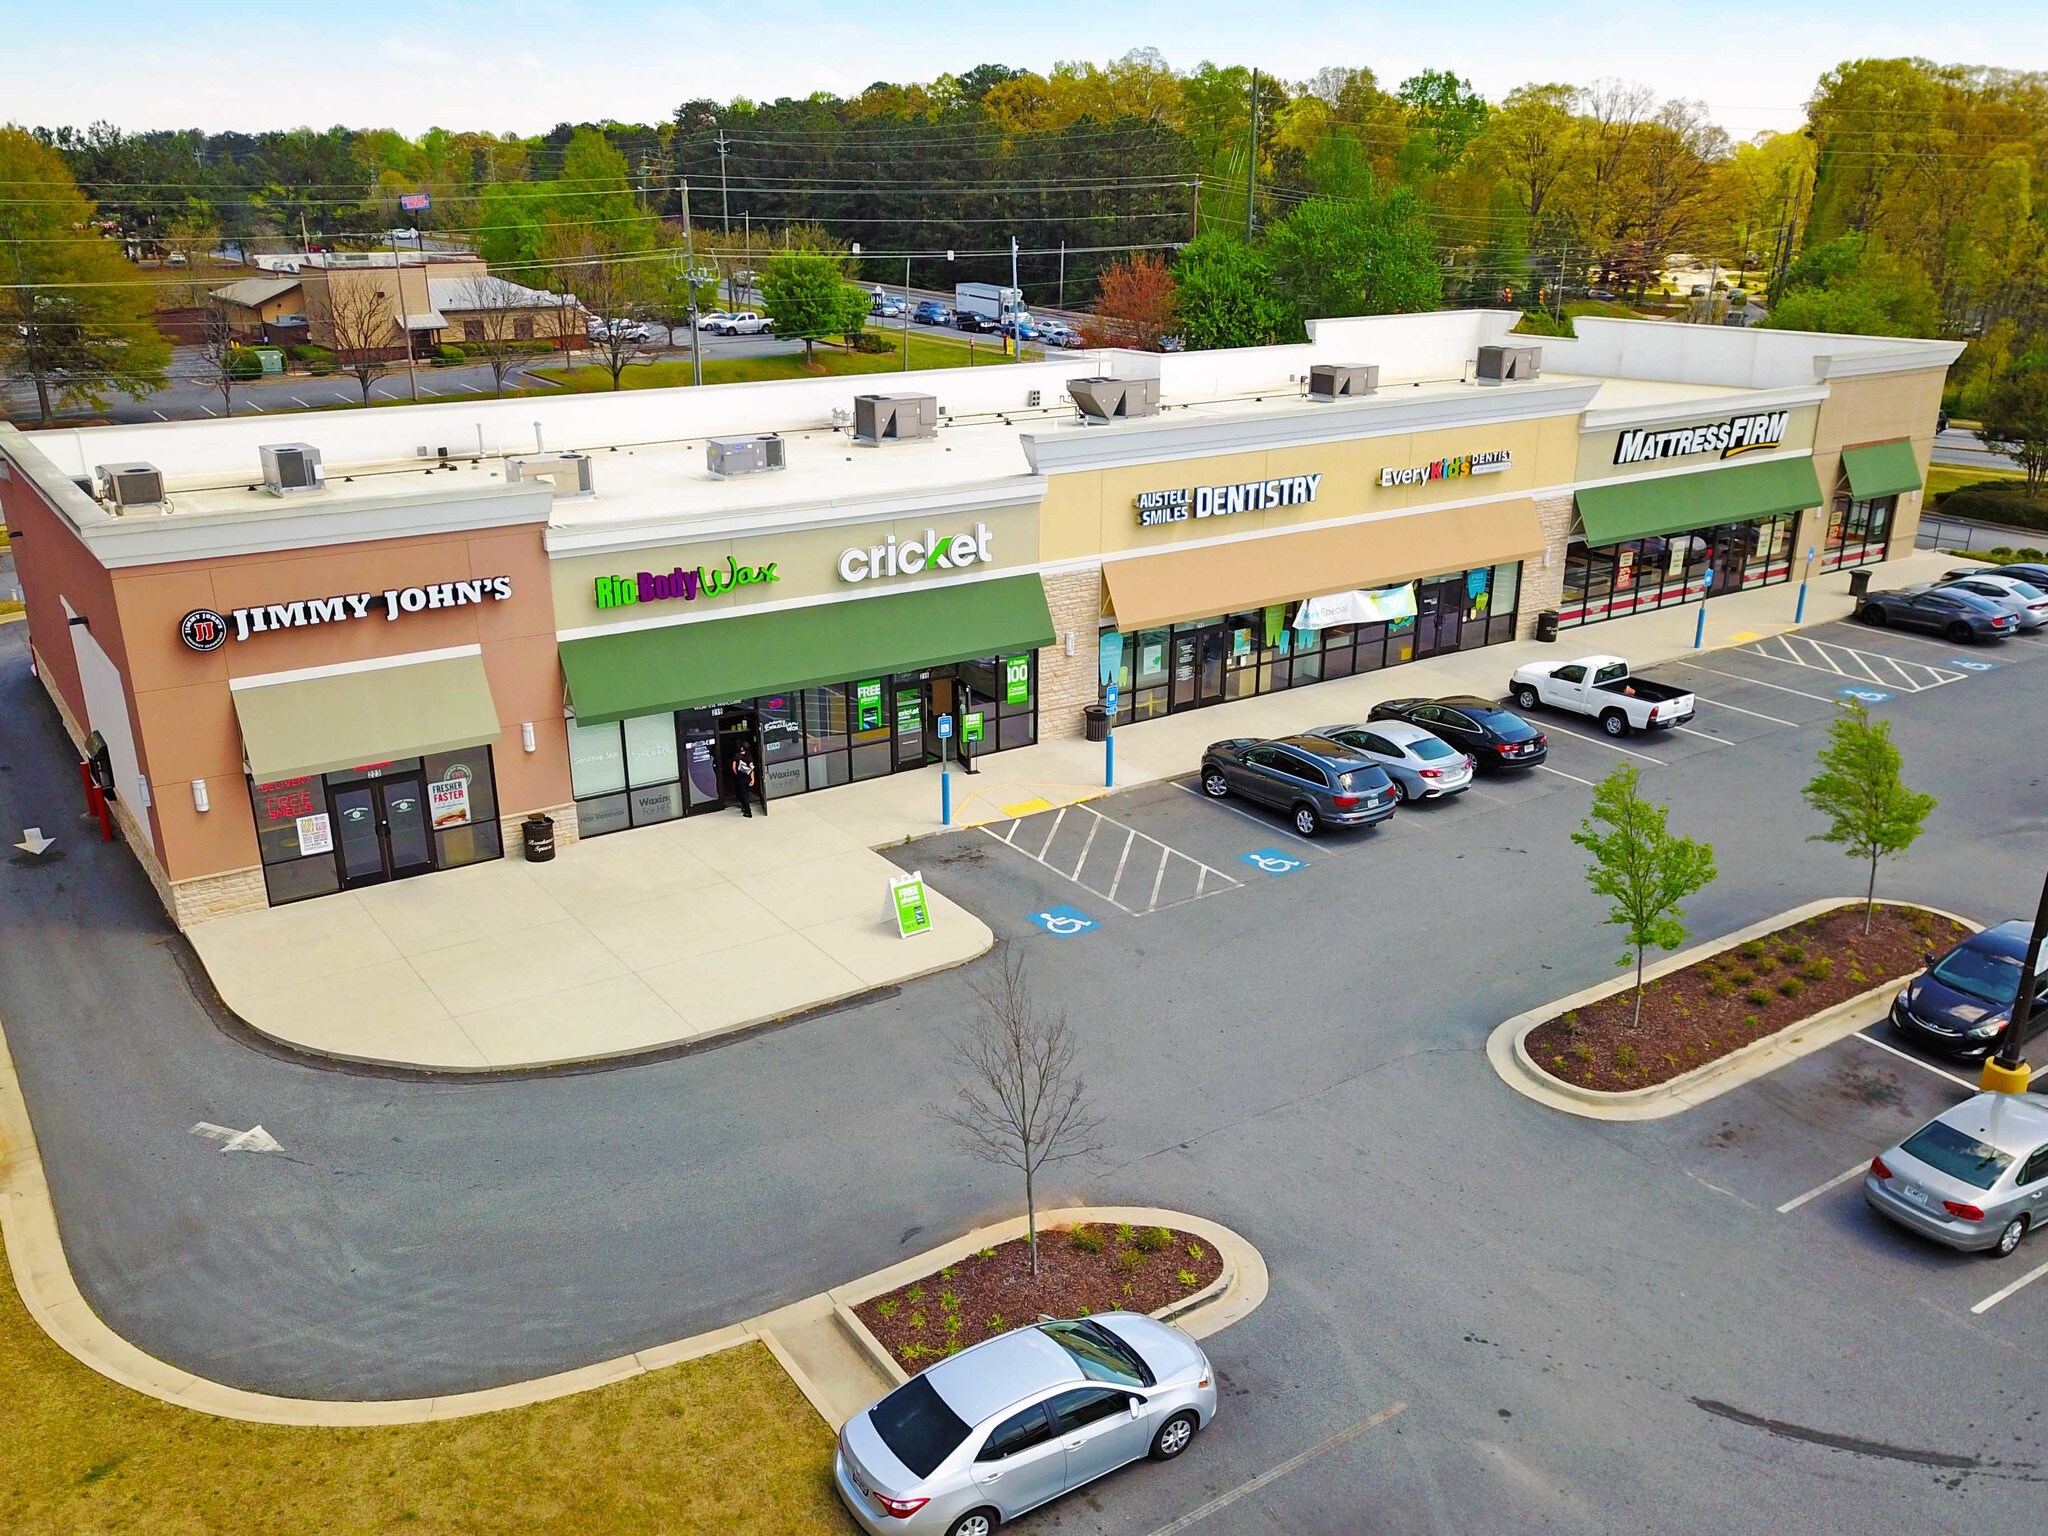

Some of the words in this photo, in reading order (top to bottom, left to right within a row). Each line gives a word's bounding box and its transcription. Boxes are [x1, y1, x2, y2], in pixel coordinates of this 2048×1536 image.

[1471, 450, 1512, 465] DENTIST
[1138, 489, 1192, 508] AUSTELL
[1194, 473, 1323, 519] DENTISTRY
[1141, 506, 1189, 526] SMILES
[838, 521, 993, 582] cricket
[232, 592, 371, 642] JIMMY
[383, 576, 512, 621] JOHN'S
[1320, 604, 1349, 618] Special
[194, 621, 214, 642] JJ
[858, 684, 881, 698] FREE
[769, 769, 800, 780] Waxing
[432, 781, 463, 794] FRESHER
[433, 790, 464, 803] FASTER
[266, 791, 312, 810] FREE
[268, 802, 313, 819] SMELLS
